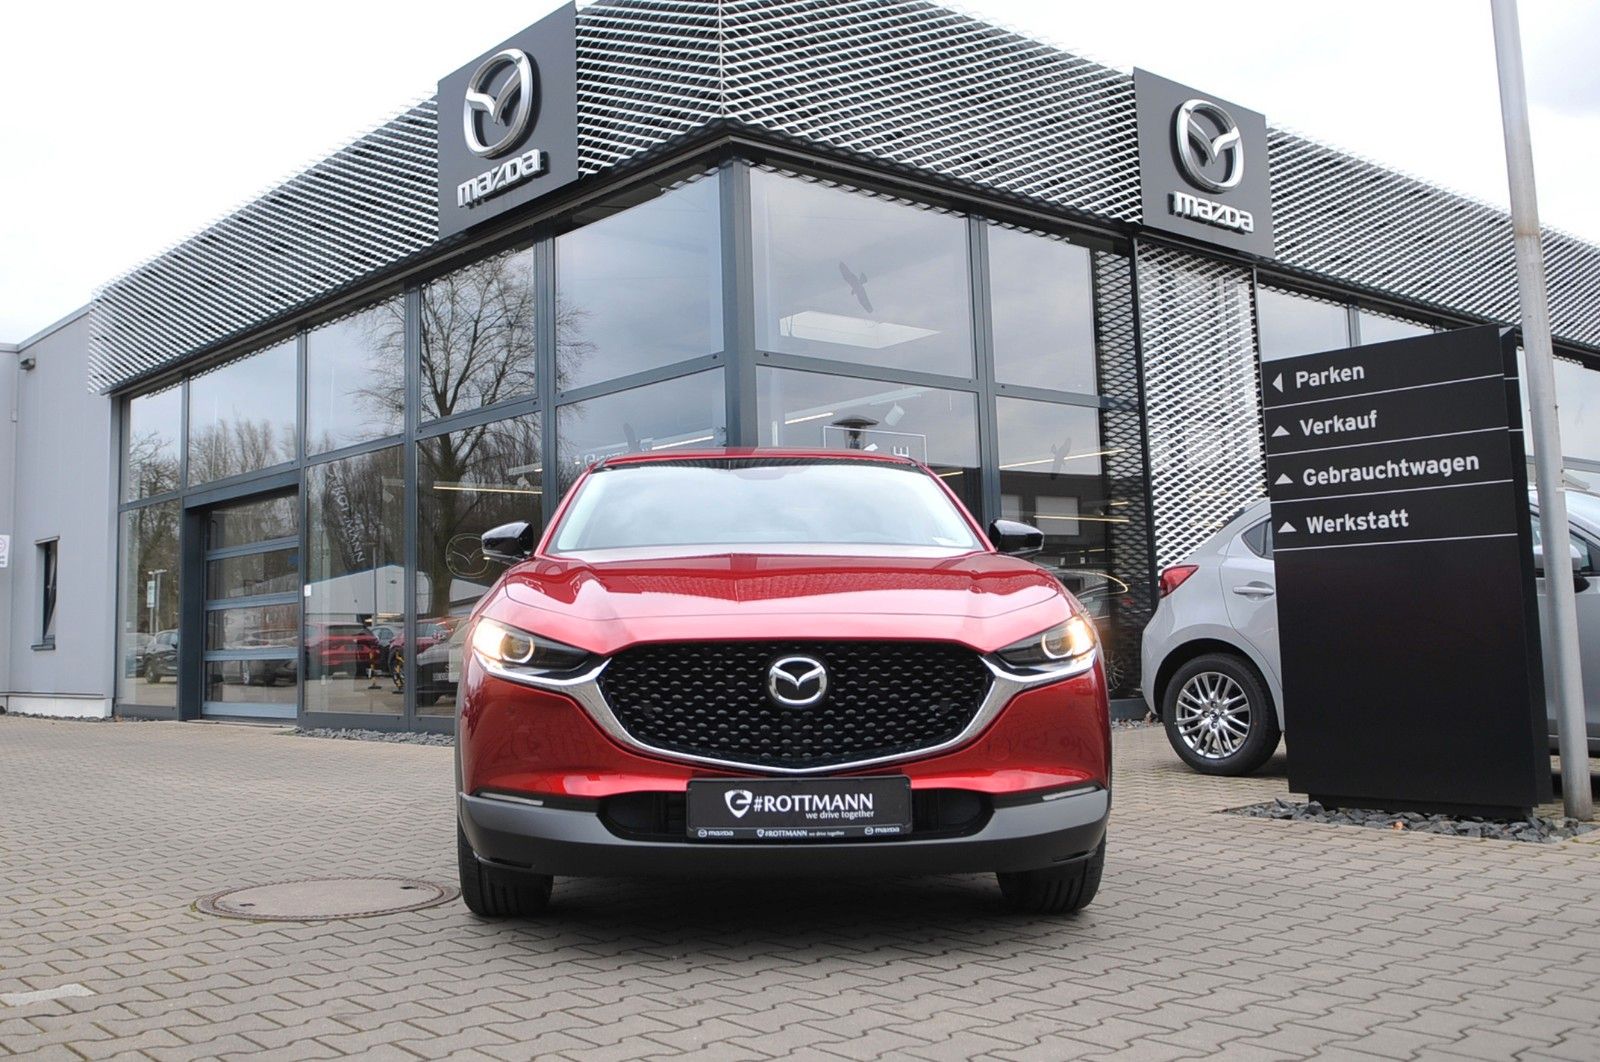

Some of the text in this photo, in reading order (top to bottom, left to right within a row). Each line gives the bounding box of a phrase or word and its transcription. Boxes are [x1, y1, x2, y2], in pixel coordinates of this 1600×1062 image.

[457, 148, 541, 208] mazda
[1174, 191, 1254, 233] mazda
[1296, 365, 1365, 388] Parken
[1300, 410, 1377, 436] Verkauf
[1303, 455, 1480, 486] Gebrauchtwagen
[1306, 509, 1409, 534] Werkstatt
[753, 793, 873, 812] #ROTTMANN
[819, 810, 839, 819] drive
[841, 809, 874, 820] together
